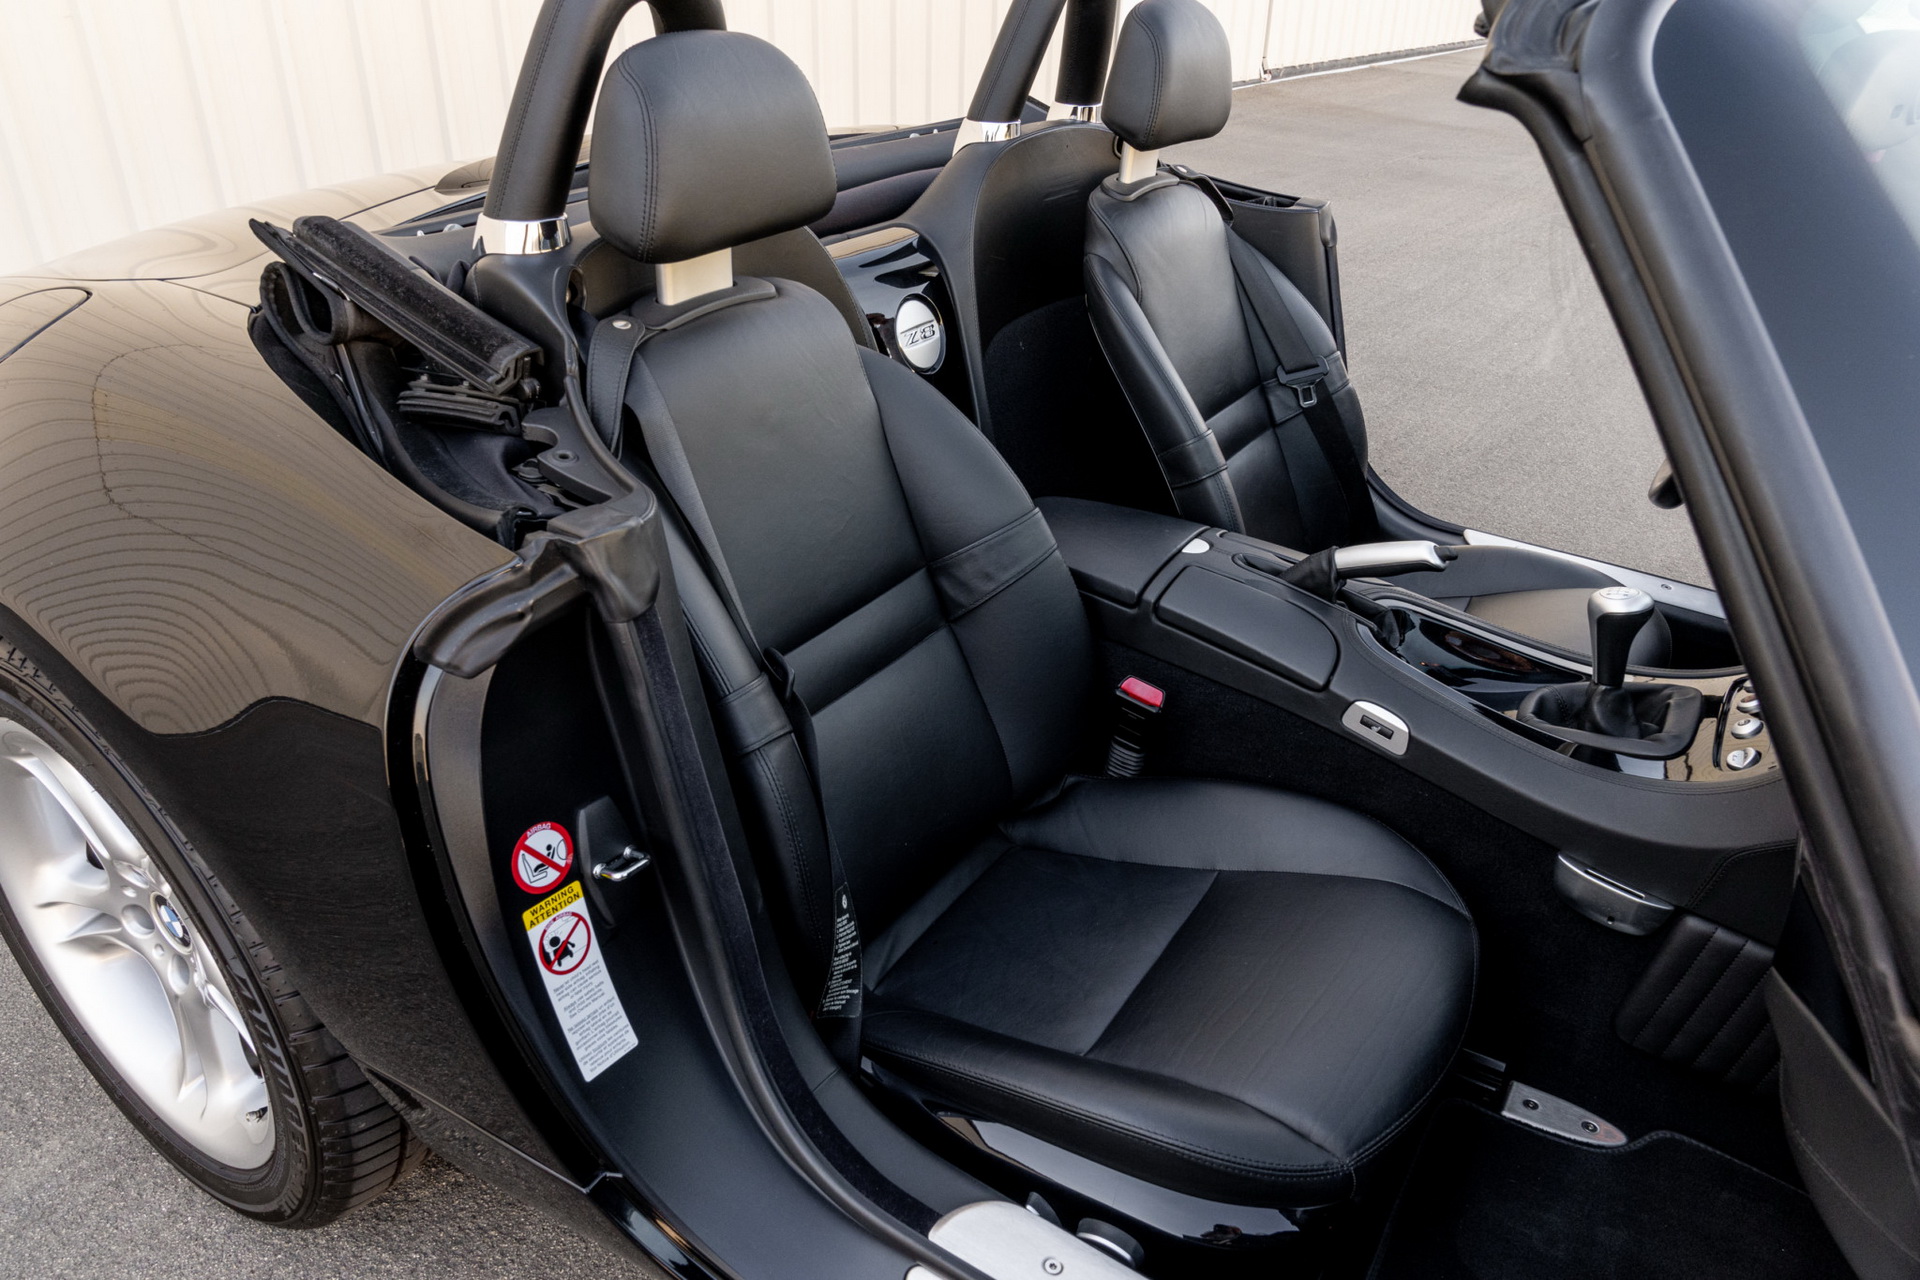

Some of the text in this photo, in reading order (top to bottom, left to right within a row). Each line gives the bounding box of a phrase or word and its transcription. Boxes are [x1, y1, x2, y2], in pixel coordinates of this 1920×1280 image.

[904, 323, 935, 347] Z8
[526, 823, 551, 838] AIRBAG
[529, 886, 574, 916] WARNING
[529, 891, 580, 928] ATTENTION
